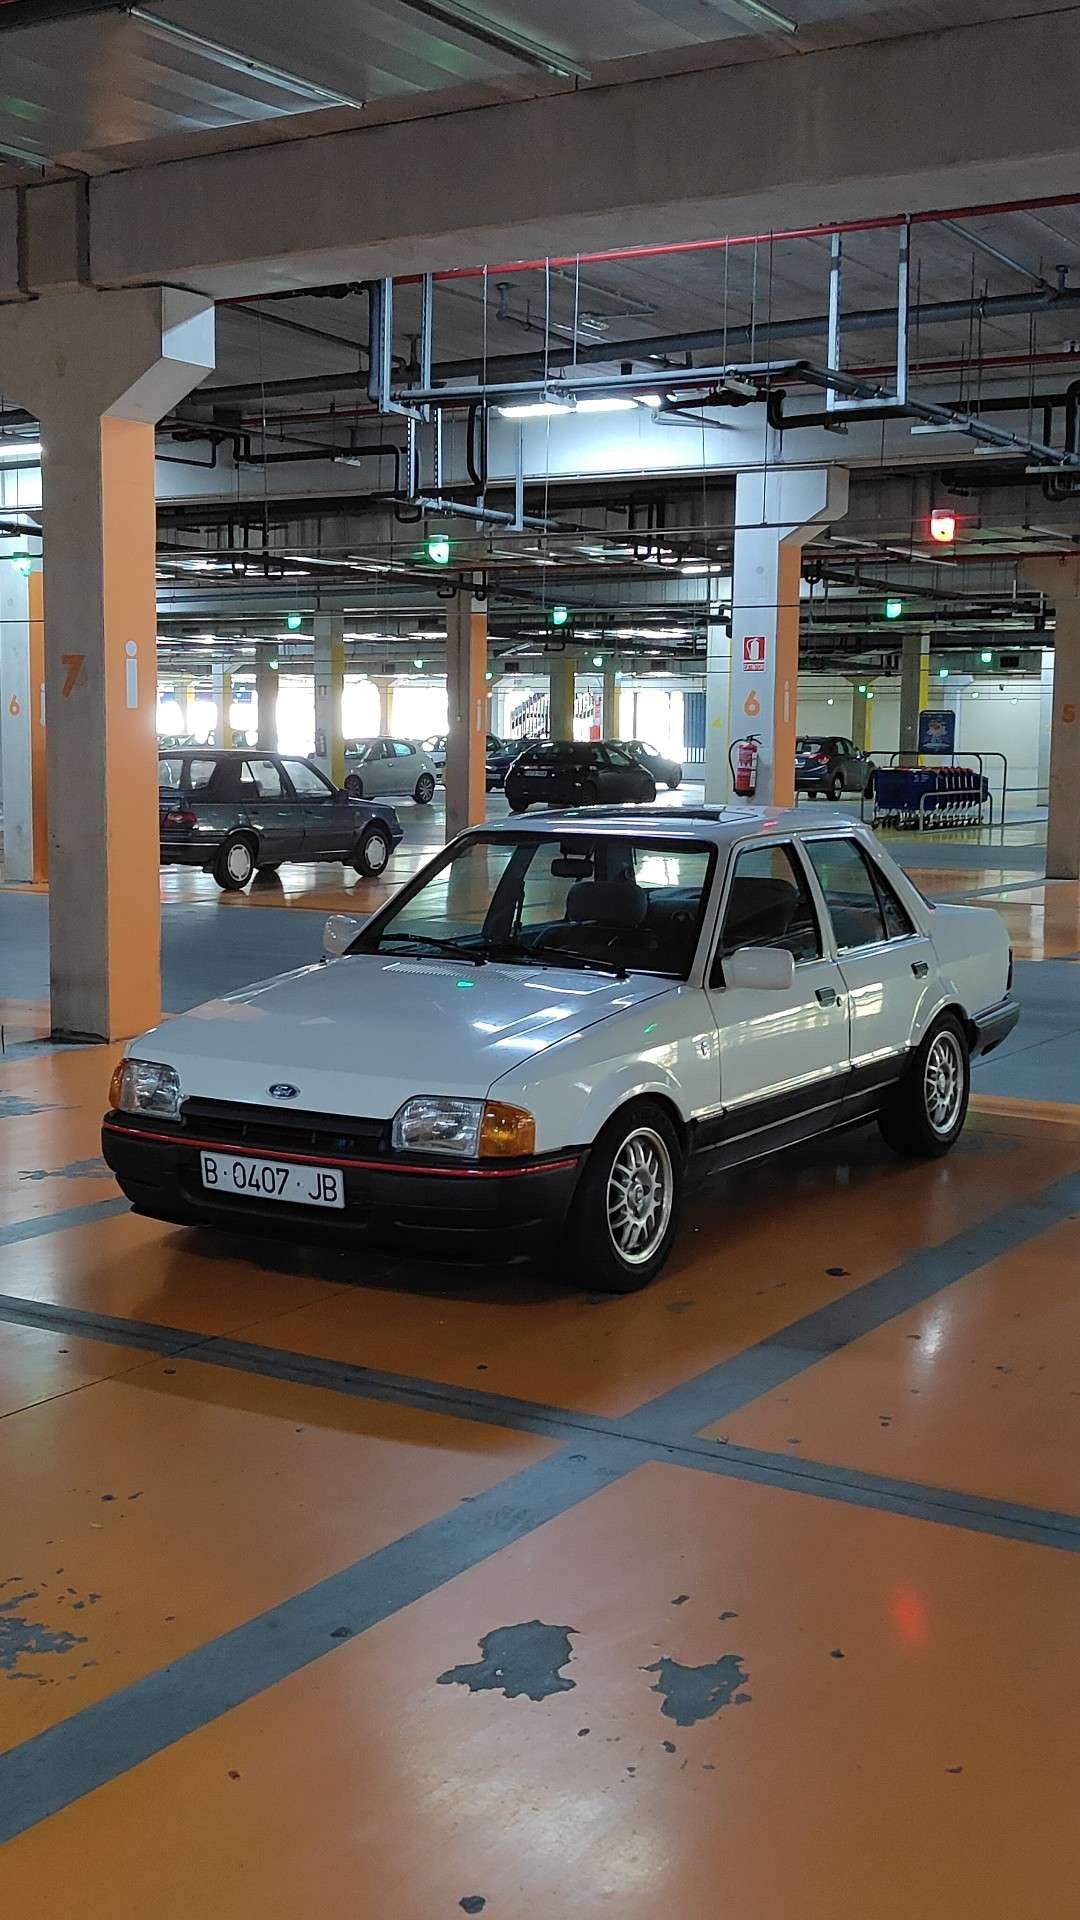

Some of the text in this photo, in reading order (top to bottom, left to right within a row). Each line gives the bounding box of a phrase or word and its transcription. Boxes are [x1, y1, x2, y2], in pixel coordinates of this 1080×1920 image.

[61, 654, 86, 697] 7
[9, 694, 20, 716] 6
[743, 688, 761, 717] 6
[1062, 704, 1076, 723] 5
